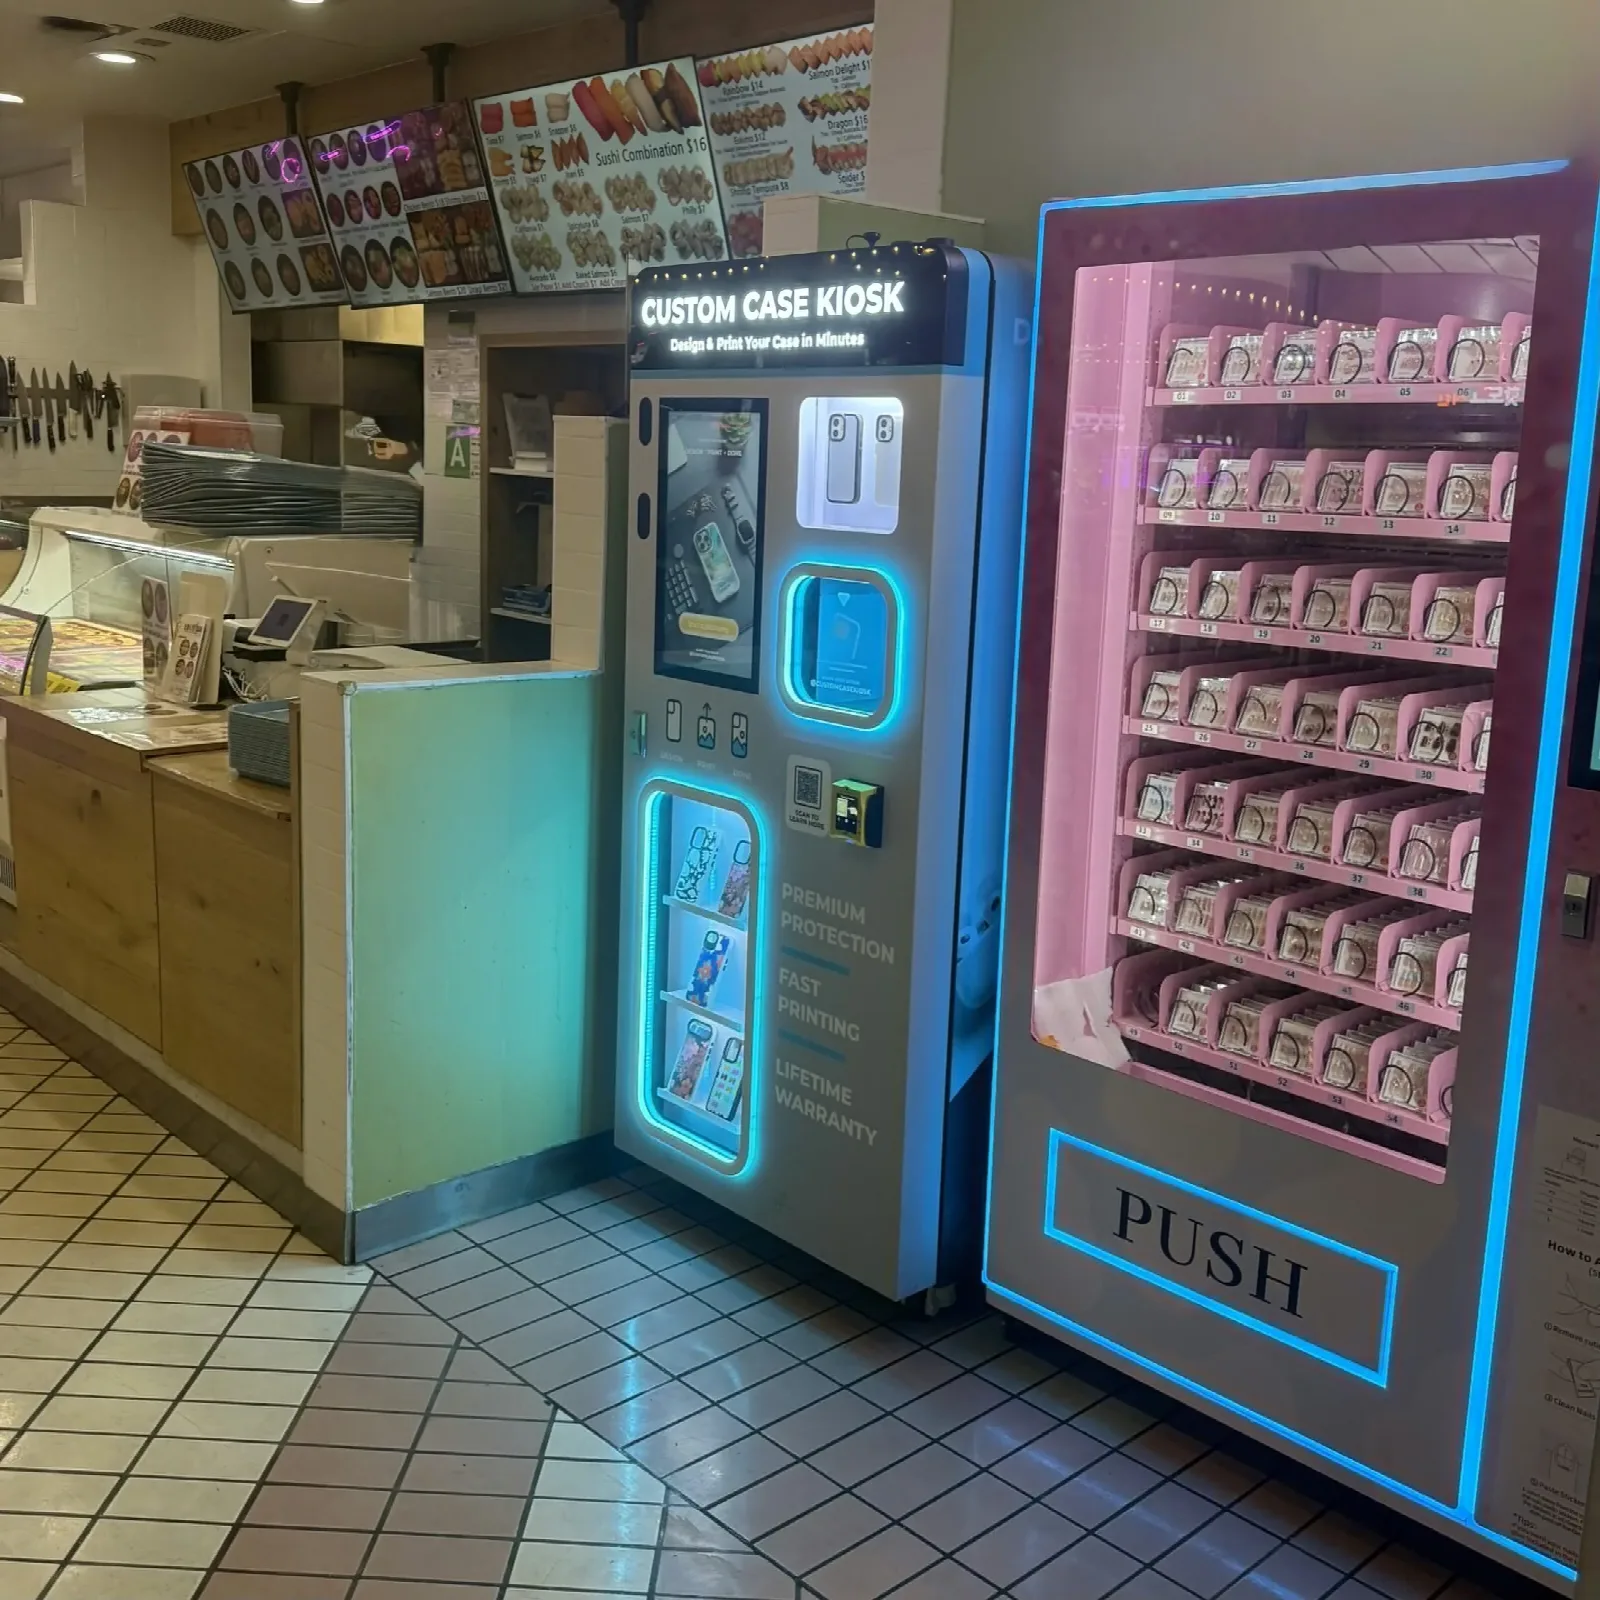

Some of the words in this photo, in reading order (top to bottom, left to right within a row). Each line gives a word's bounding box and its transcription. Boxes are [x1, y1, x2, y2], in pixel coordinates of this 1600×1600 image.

[808, 70, 834, 81] Salmon
[835, 61, 860, 75] Delight
[827, 119, 853, 130] Dragon
[596, 151, 621, 167] Sushi
[622, 142, 685, 162] Combination
[686, 137, 707, 155] $16
[641, 295, 735, 326] CUSTOM
[743, 287, 809, 321] CASE
[817, 280, 905, 317] KIOSK
[670, 337, 705, 354] Design
[707, 338, 714, 351] &
[717, 334, 743, 351] Print
[745, 335, 771, 350] Your
[772, 334, 801, 350] Case
[802, 332, 813, 348] in
[815, 331, 865, 348] Minutes
[1334, 390, 1346, 398] 04
[1400, 388, 1411, 396] 05
[450, 438, 466, 467] A
[1210, 512, 1221, 521] 10
[1267, 515, 1277, 523] 11
[1324, 517, 1335, 526] 12
[1383, 520, 1394, 529] 13
[1447, 525, 1459, 534] 14
[1309, 635, 1321, 643] 20
[1371, 641, 1382, 650] 21
[1435, 647, 1447, 656] 22
[1358, 759, 1370, 768] 29
[795, 809, 811, 818] SCAN
[811, 813, 820, 821] TO
[789, 815, 808, 826] LEARN
[809, 820, 825, 831] MORE
[782, 882, 867, 925] PREMIUM
[781, 910, 896, 965] PROTECTION
[778, 967, 821, 998] FAST
[778, 996, 861, 1042] PRINTING
[775, 1057, 853, 1107] LIFETIME
[1278, 1077, 1288, 1086] 52
[774, 1086, 878, 1146] WARRANTY
[1113, 1187, 1309, 1319] PUSH
[1548, 1239, 1577, 1258] How
[1578, 1250, 1592, 1263] to
